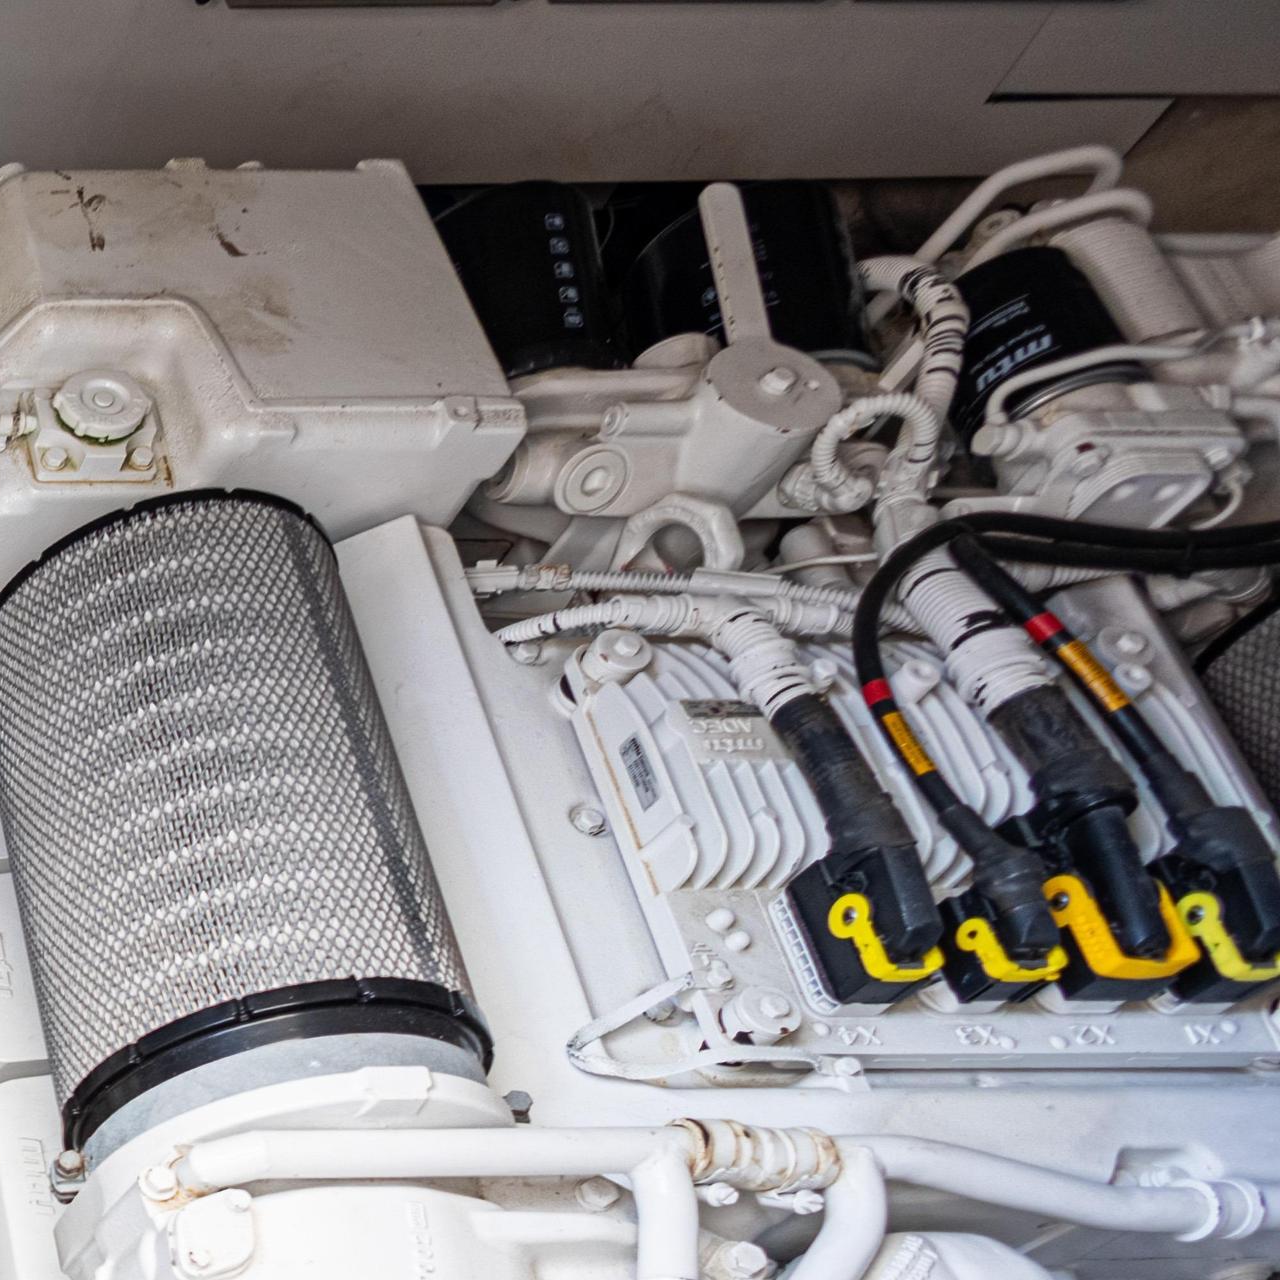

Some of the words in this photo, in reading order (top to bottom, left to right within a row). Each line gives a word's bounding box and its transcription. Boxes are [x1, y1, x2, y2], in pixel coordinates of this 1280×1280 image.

[976, 333, 1053, 393] mtu
[688, 718, 752, 733] ADEC
[703, 738, 765, 753] mtu
[839, 1024, 884, 1046] X4
[956, 1023, 1000, 1046] X3
[1070, 1023, 1116, 1046] X2
[1183, 1022, 1222, 1046] X1
